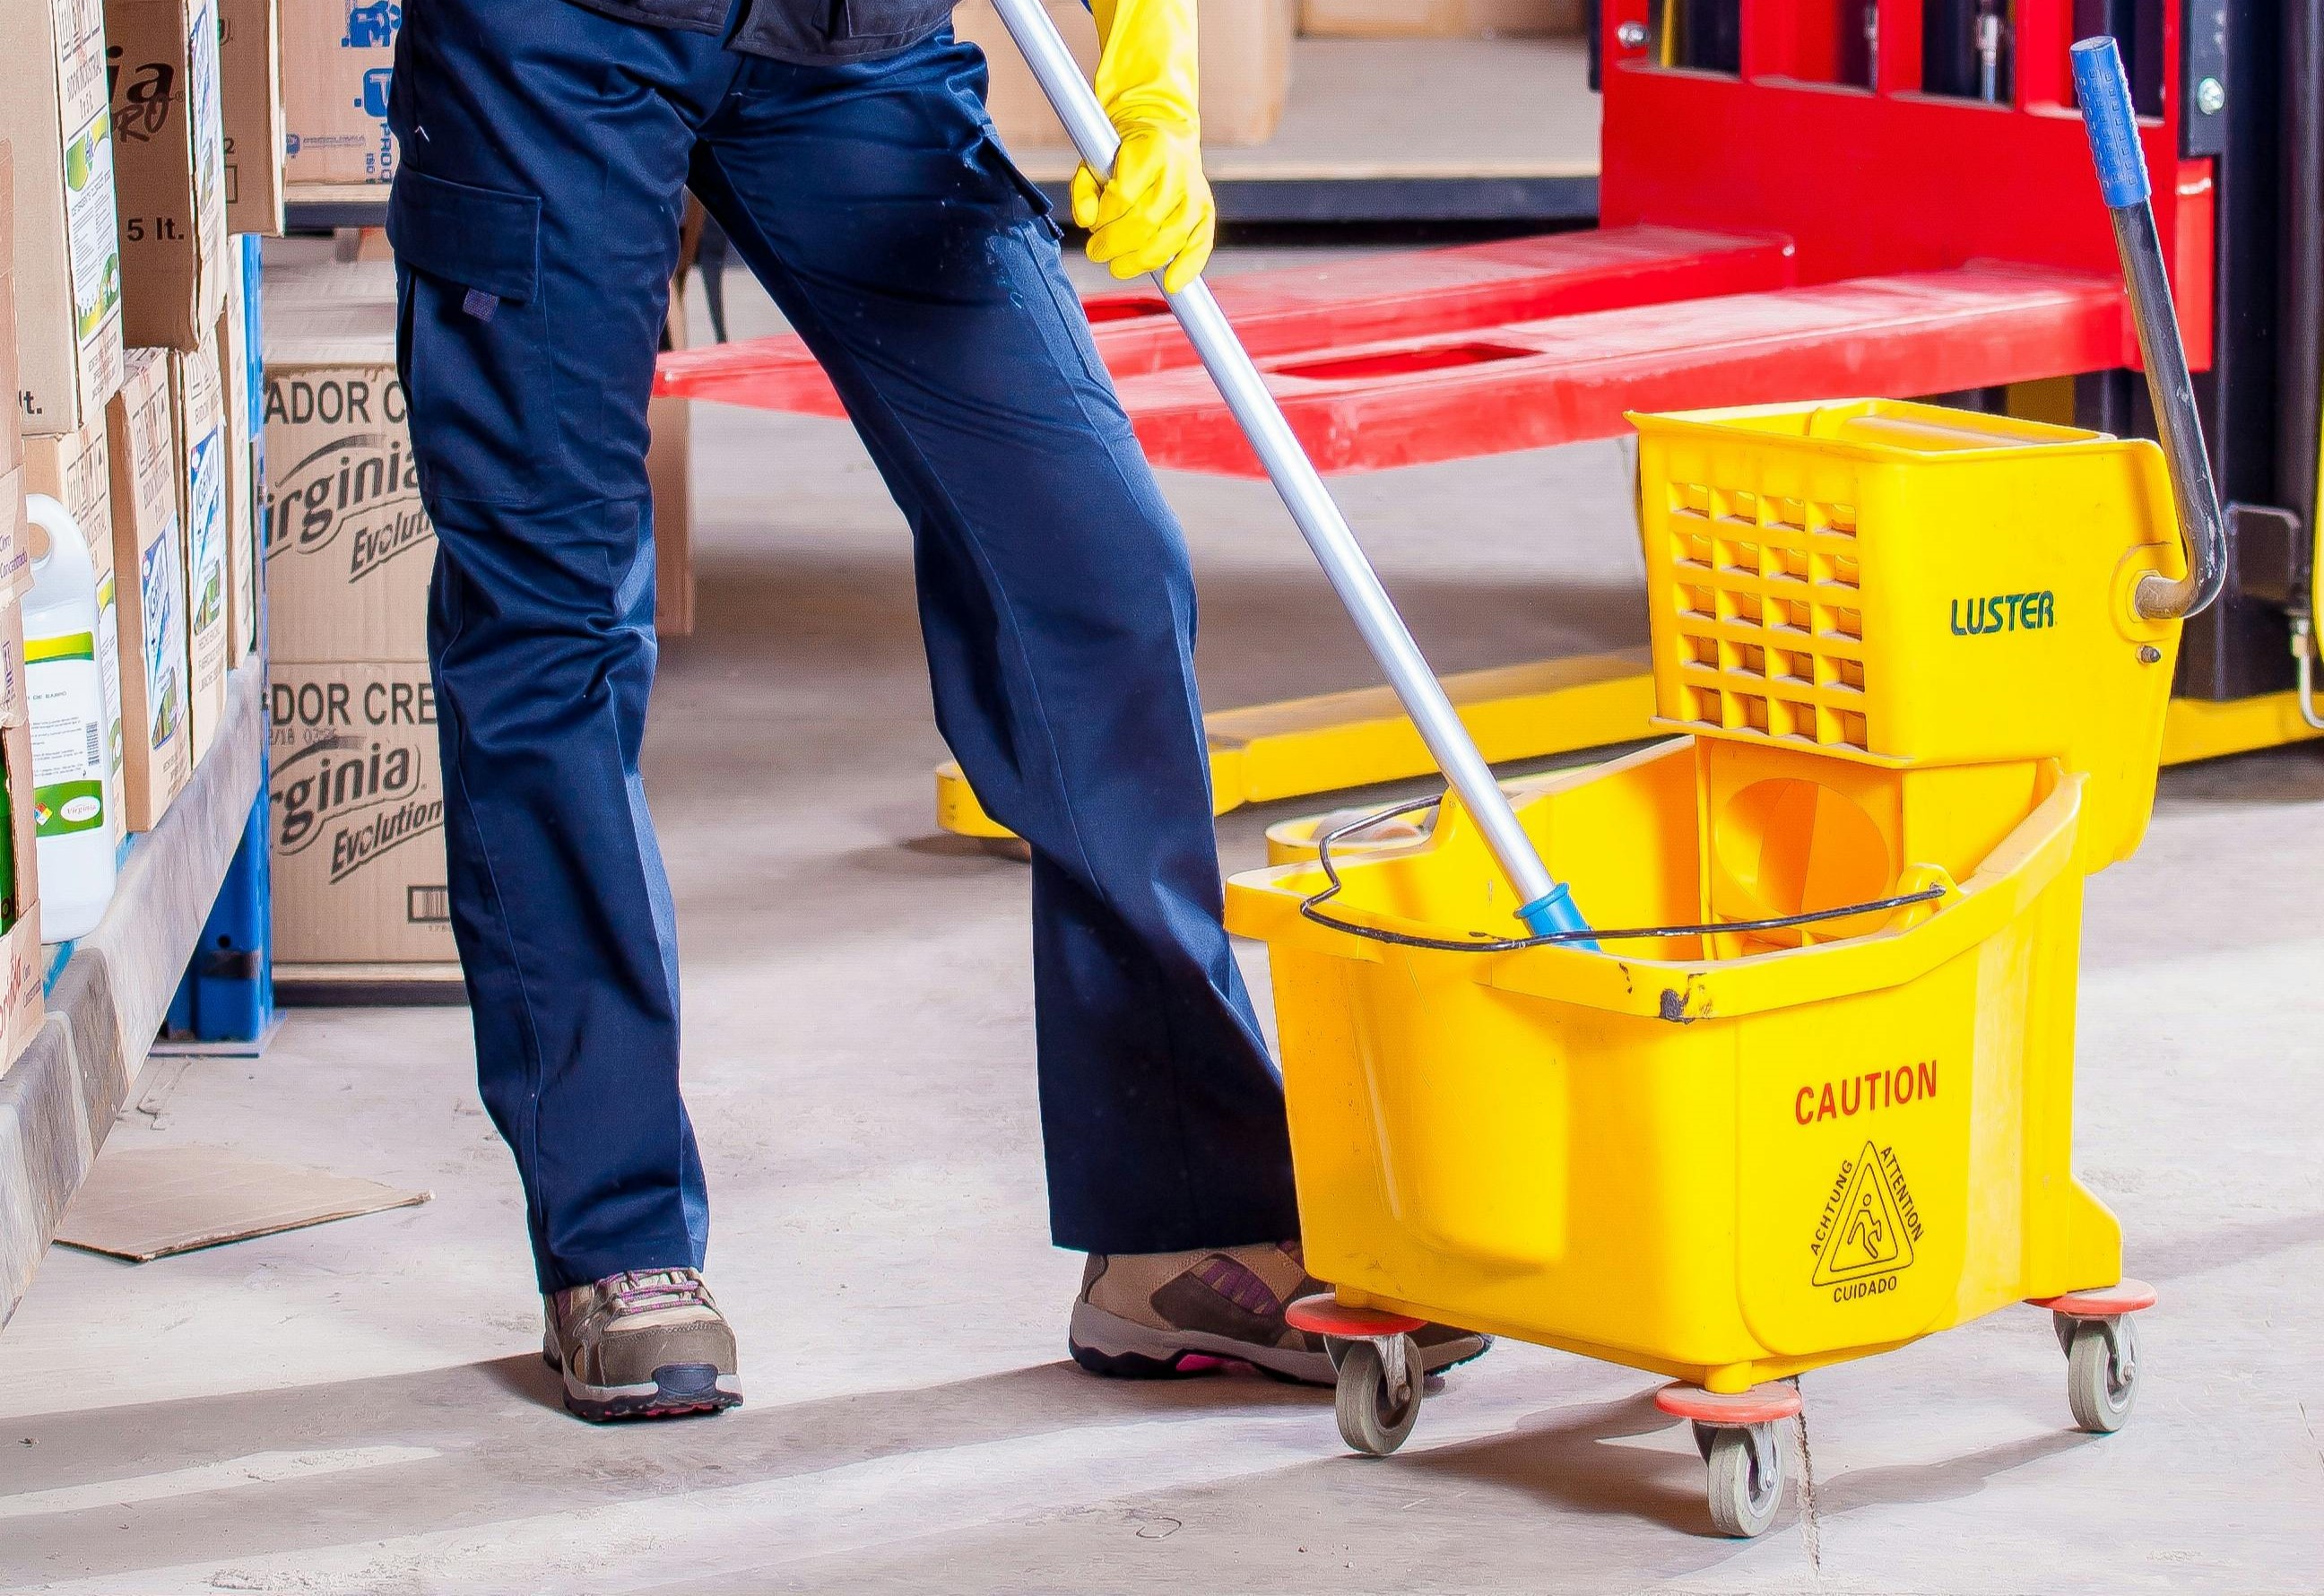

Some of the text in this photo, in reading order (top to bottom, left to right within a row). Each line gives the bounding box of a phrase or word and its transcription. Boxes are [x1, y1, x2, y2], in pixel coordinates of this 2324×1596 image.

[127, 217, 185, 241] 5 lt.
[264, 380, 371, 424] ADOR
[1950, 590, 2054, 636] LUSTER
[272, 682, 437, 725] DOR CRE
[331, 800, 443, 875] Evolution
[1795, 1060, 1937, 1125] CAUTION
[1810, 1159, 1853, 1256] ACHTUNG
[1880, 1146, 1924, 1243] ATTENTION
[1834, 1275, 1897, 1304] CUIDADO
